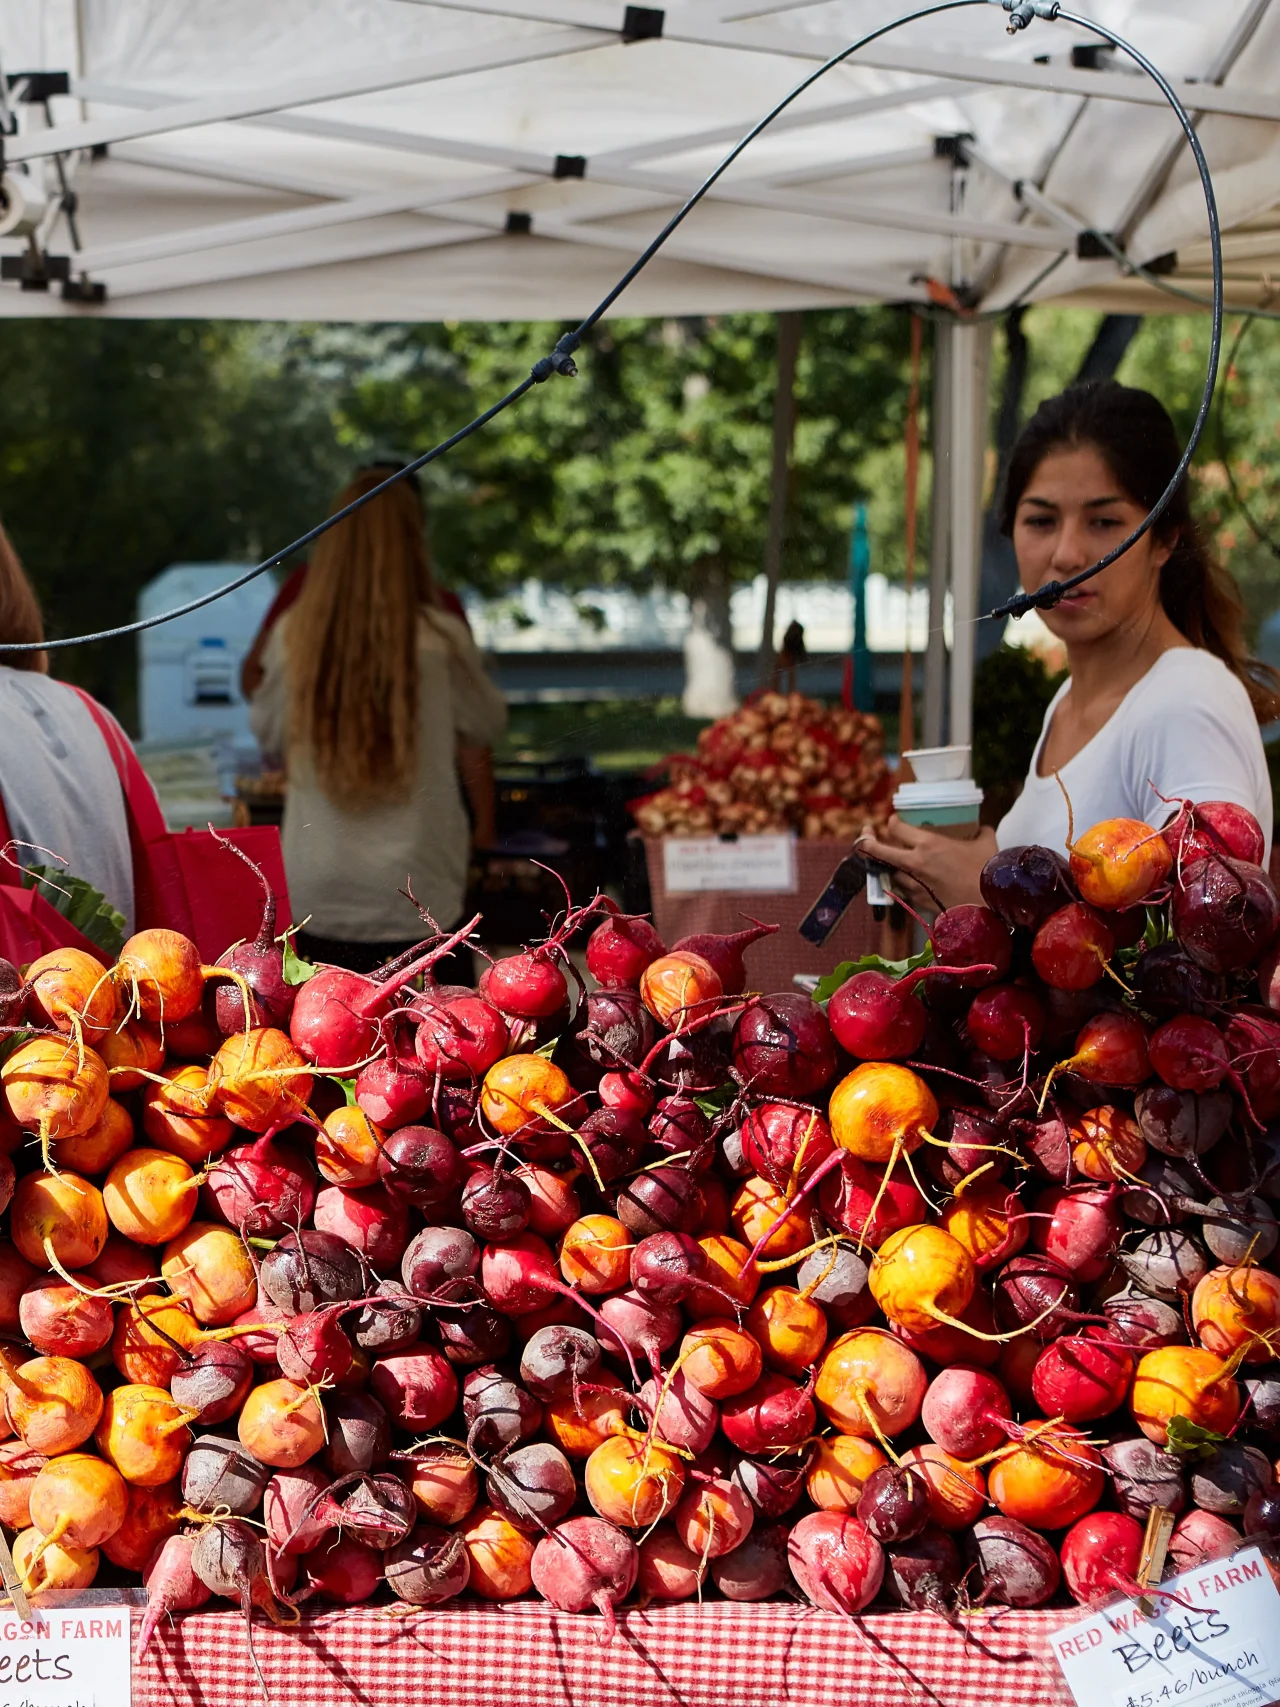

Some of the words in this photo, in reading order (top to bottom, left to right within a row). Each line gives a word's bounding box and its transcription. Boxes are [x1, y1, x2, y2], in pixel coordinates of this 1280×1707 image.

[61, 1619, 123, 1639] FARM
[1058, 1628, 1104, 1660] RED
[1198, 1560, 1263, 1597] FARM
[1112, 1611, 1229, 1674] Beets
